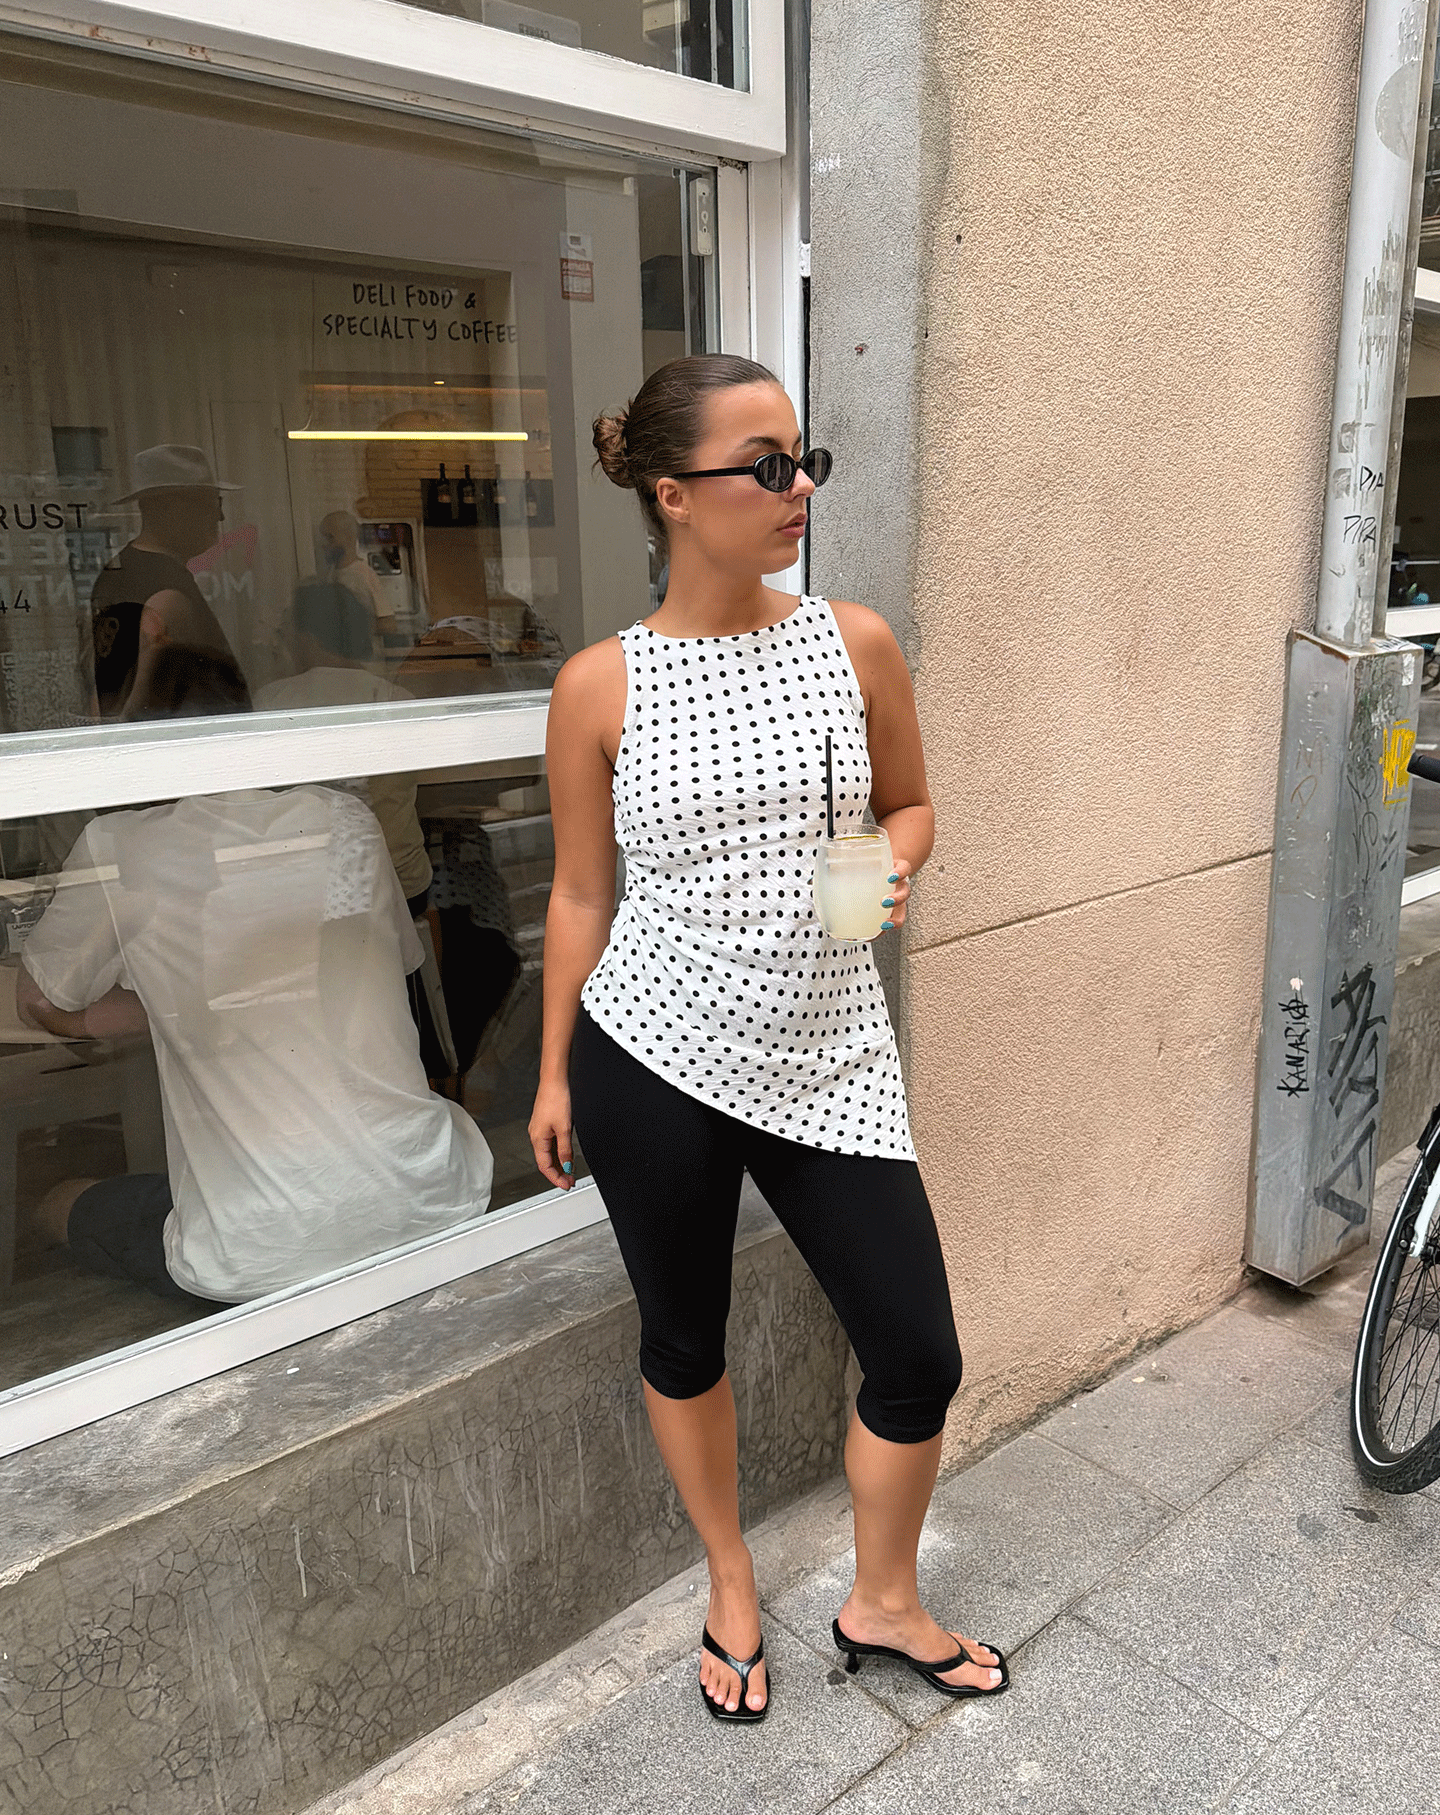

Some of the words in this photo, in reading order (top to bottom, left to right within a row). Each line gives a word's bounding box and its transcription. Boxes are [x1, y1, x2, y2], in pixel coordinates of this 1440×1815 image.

[353, 282, 395, 307] DELI
[406, 284, 453, 309] FOOD
[464, 292, 476, 309] &
[322, 313, 437, 341] SPECIALTY
[447, 319, 517, 344] COFFEE
